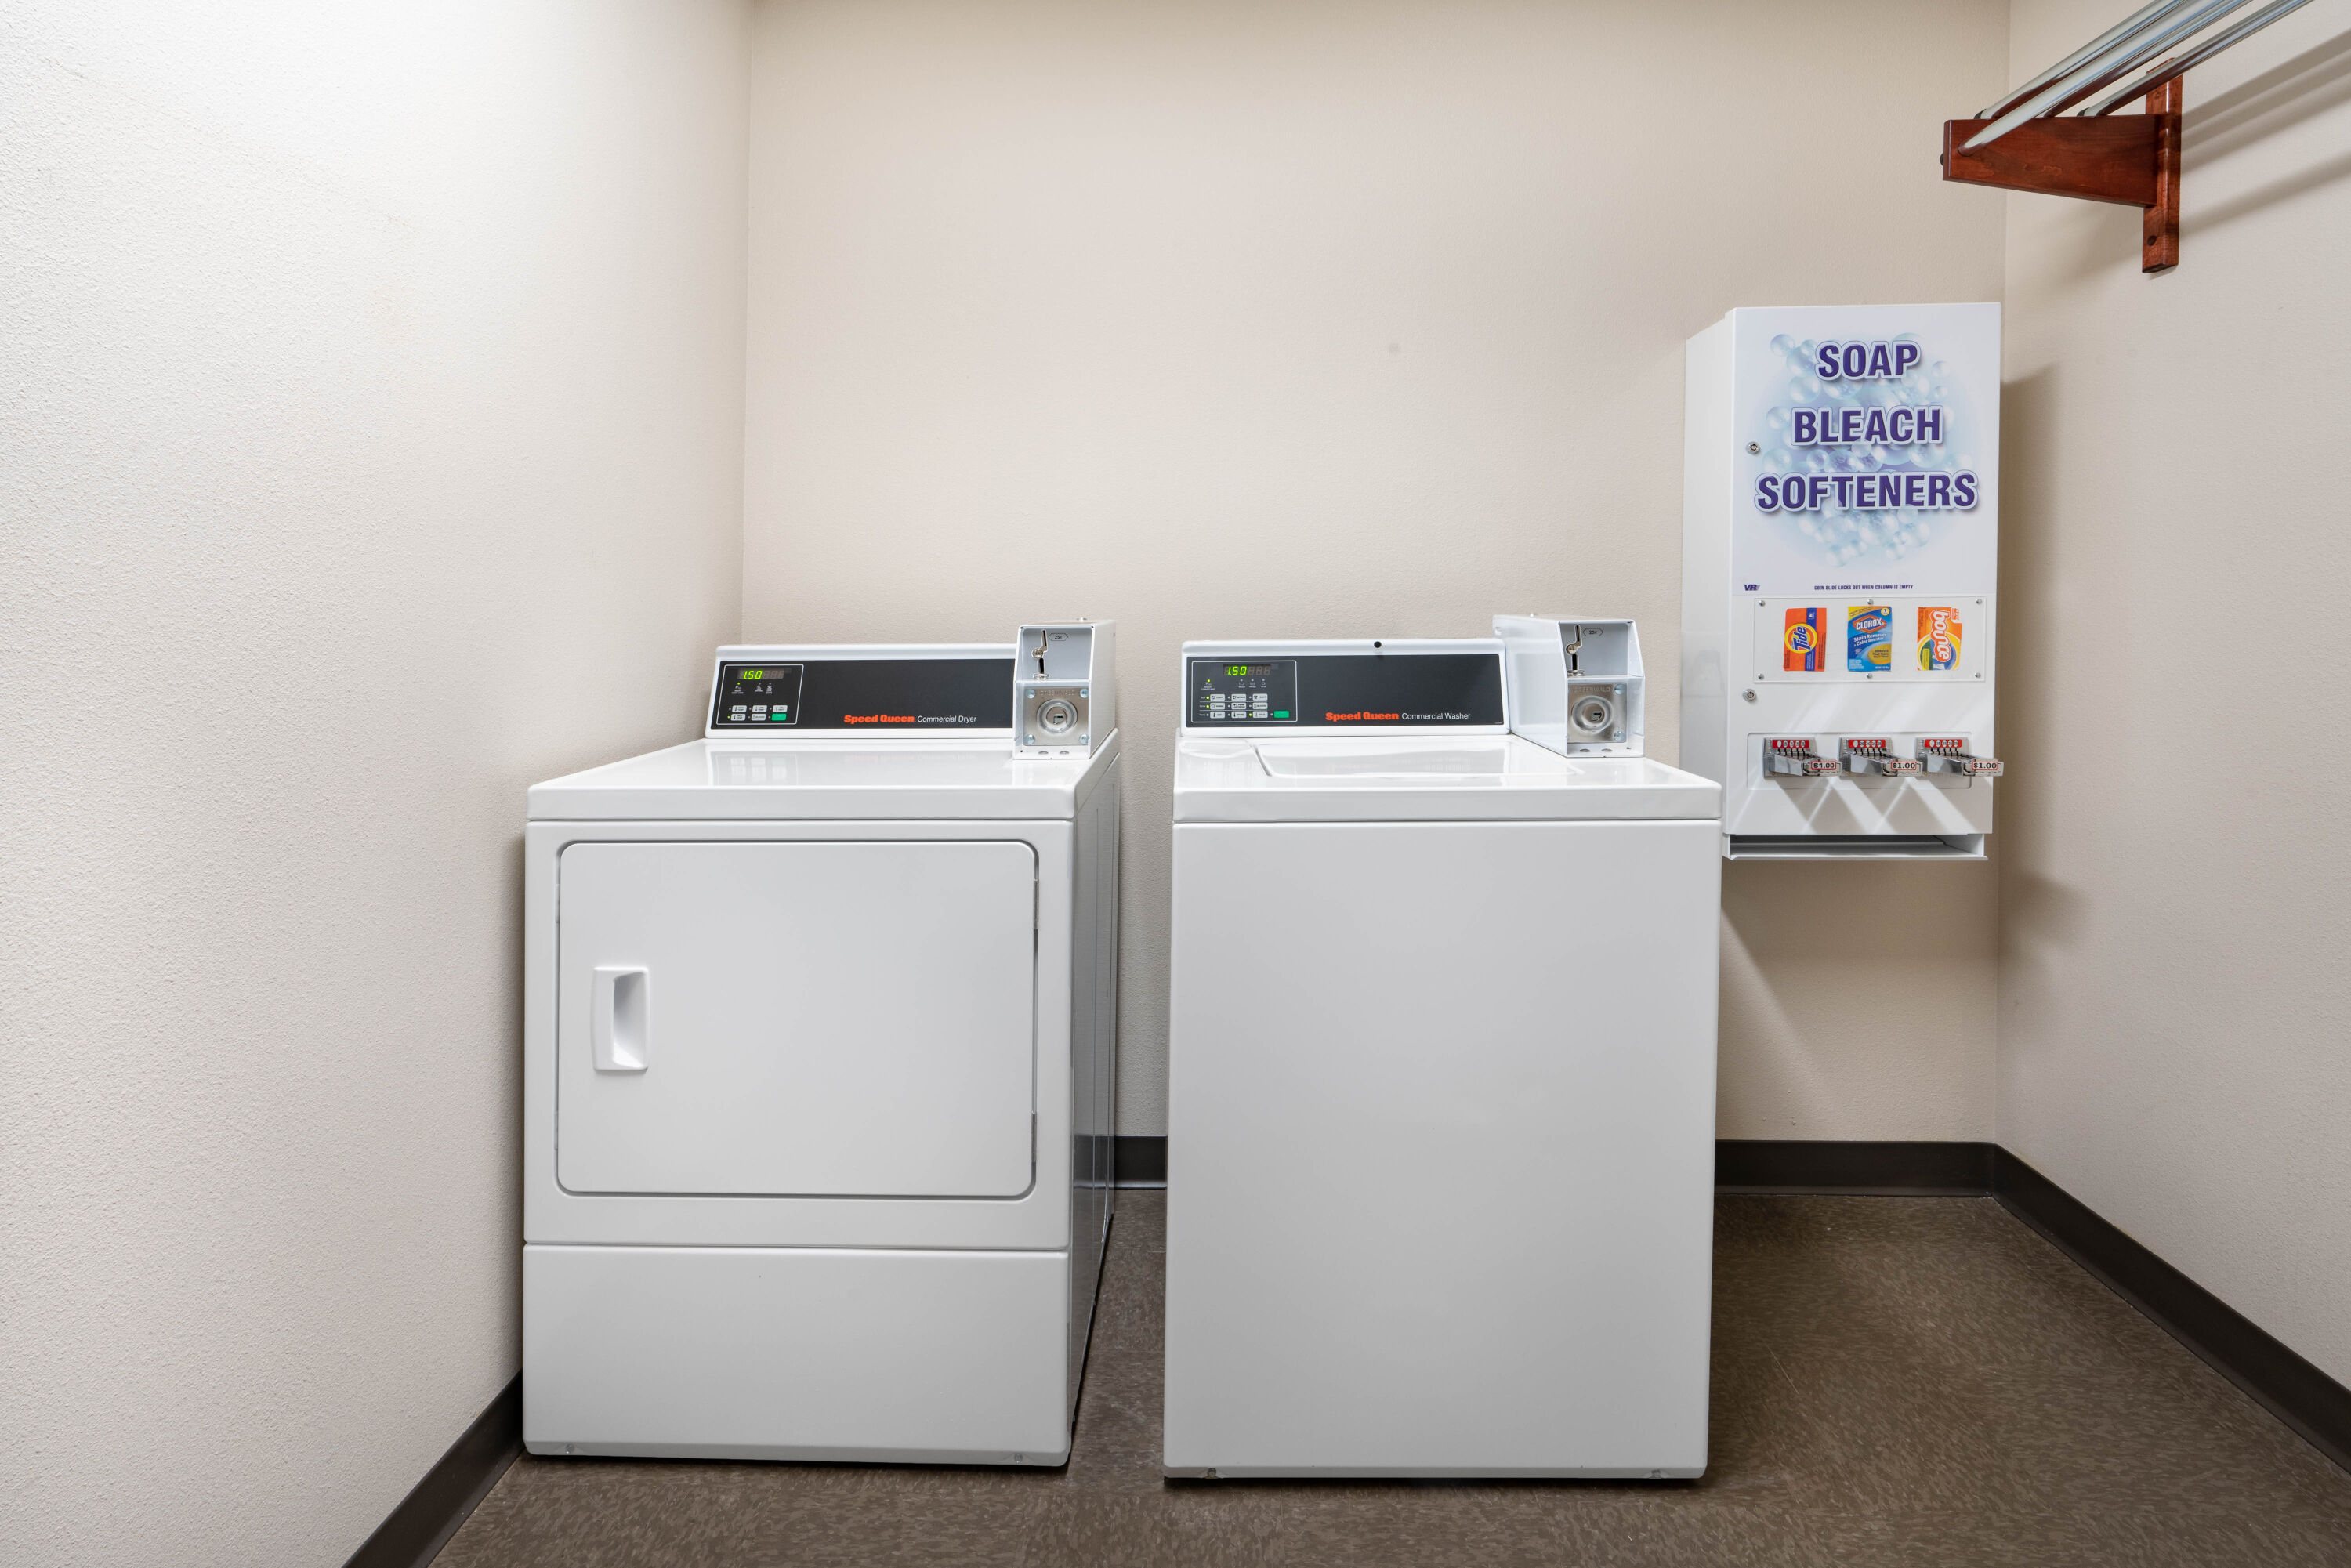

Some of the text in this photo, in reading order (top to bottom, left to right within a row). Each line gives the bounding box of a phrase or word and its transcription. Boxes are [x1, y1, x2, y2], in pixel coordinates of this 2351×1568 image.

[1817, 342, 1919, 378] SOAP
[1793, 407, 1941, 444] BLEACH
[1756, 473, 1976, 510] SOFTENERS
[1791, 626, 1813, 651] Tide
[1933, 610, 1951, 660] bounce
[844, 714, 878, 724] Speed
[879, 714, 915, 723] Queen
[958, 715, 977, 724] Dryer
[1325, 712, 1362, 722] Speed
[1363, 712, 1400, 720] Queen
